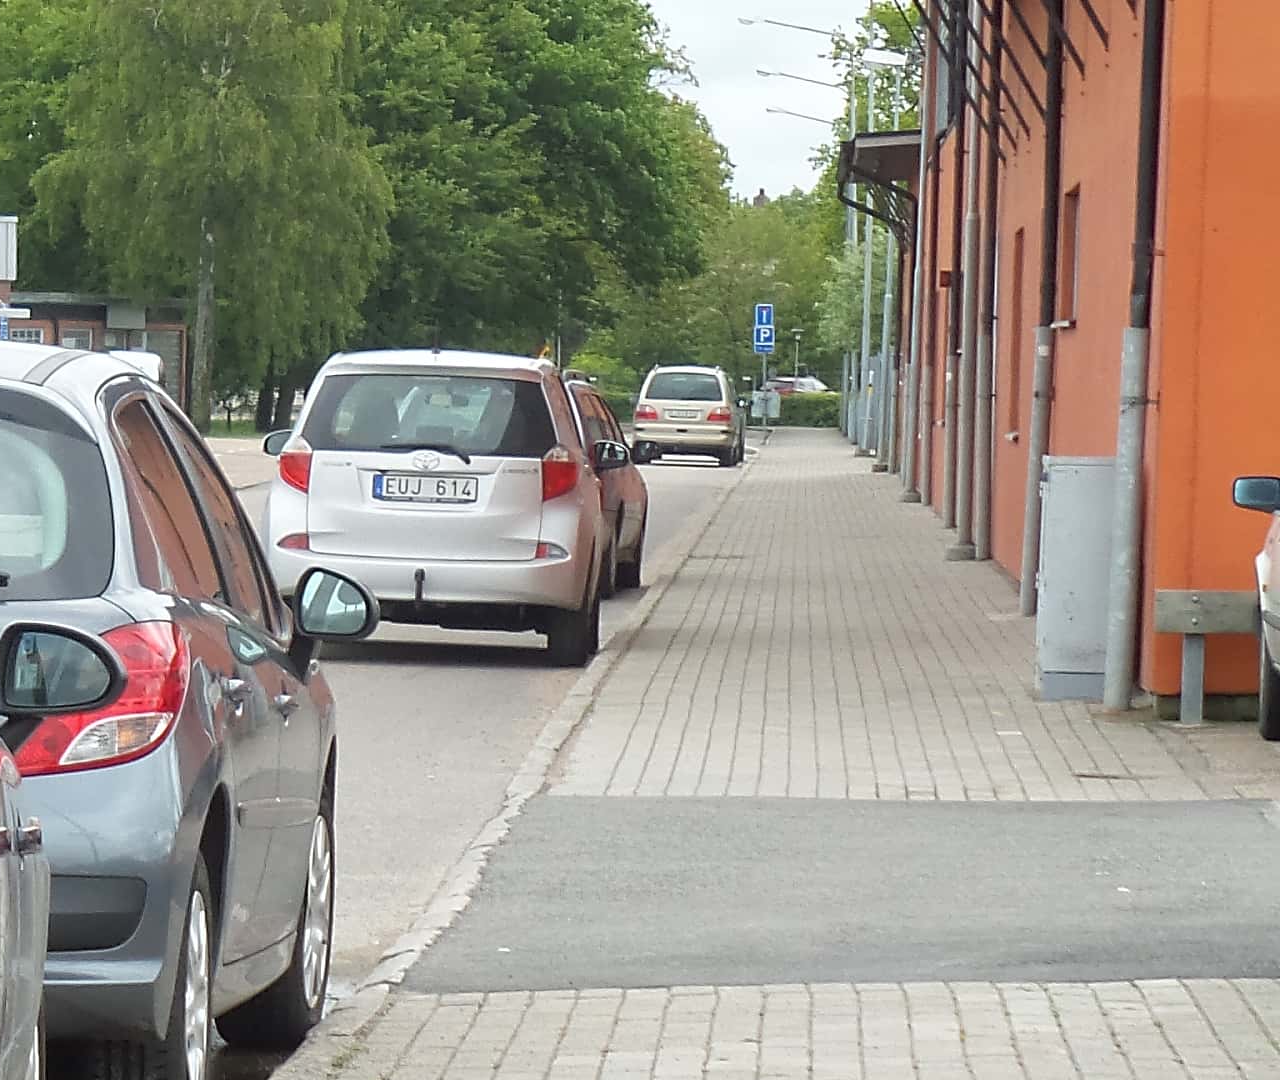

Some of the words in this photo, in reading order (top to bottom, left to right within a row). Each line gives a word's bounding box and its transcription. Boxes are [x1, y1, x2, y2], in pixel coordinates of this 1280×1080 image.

[760, 328, 770, 342] P
[385, 478, 423, 496] EUJ
[436, 479, 472, 498] 614
